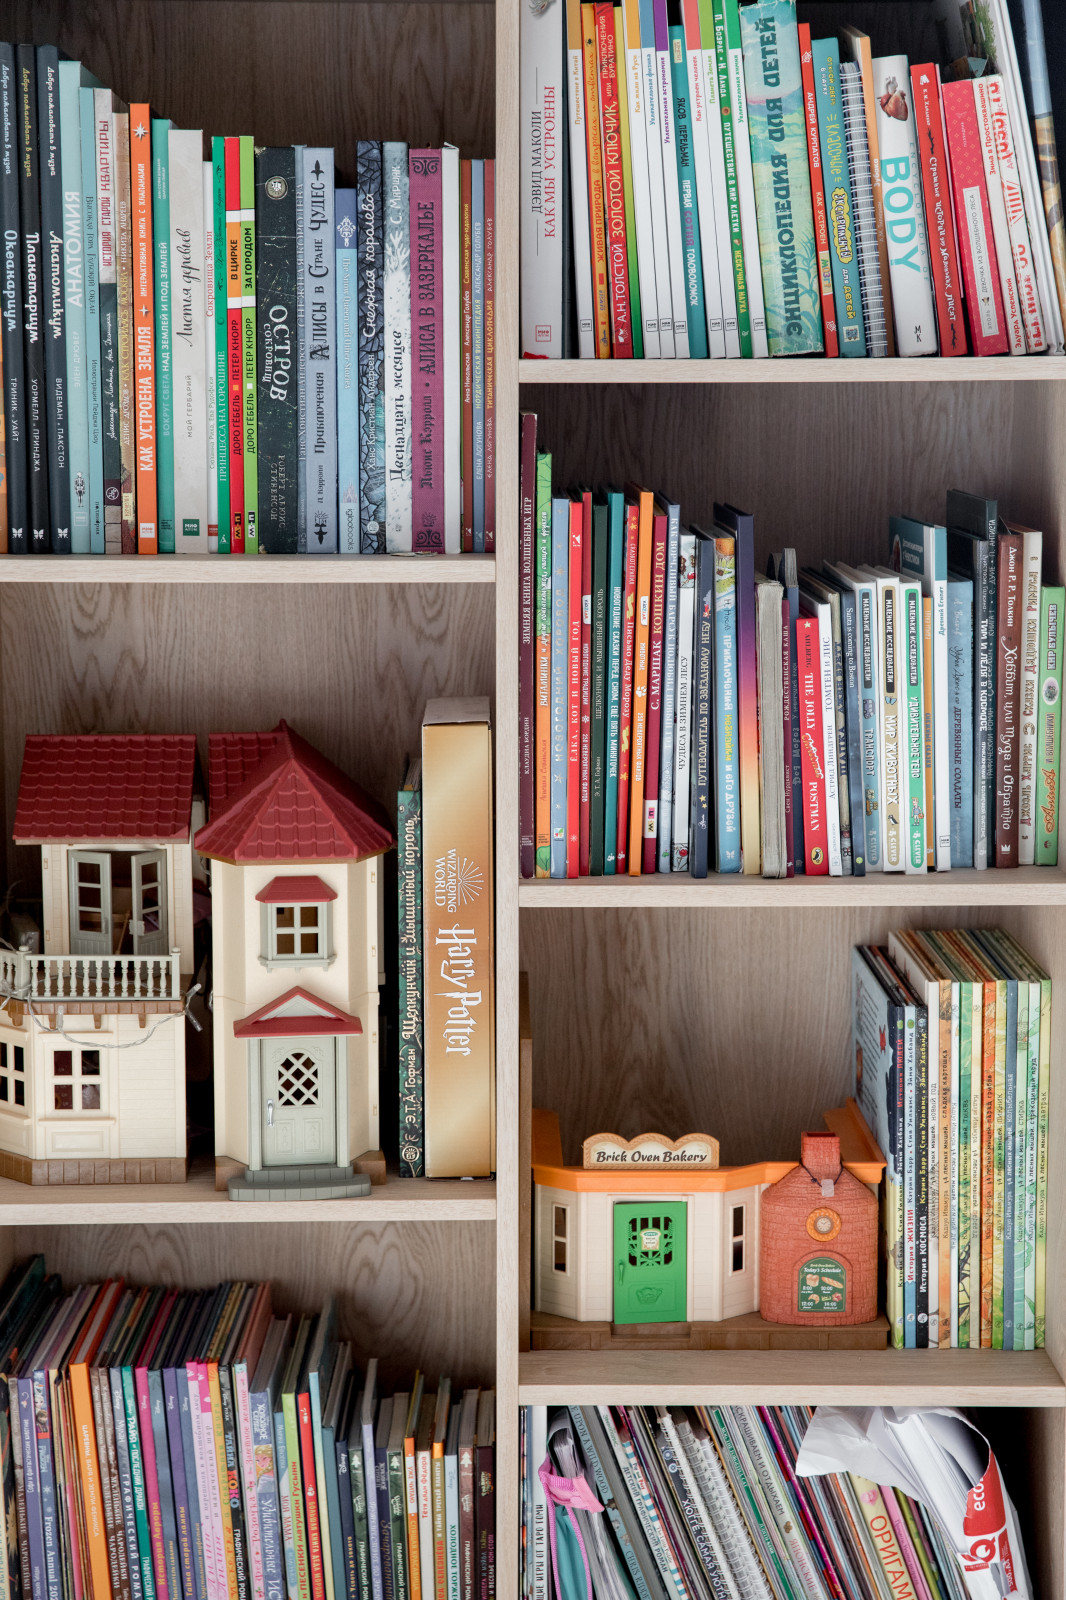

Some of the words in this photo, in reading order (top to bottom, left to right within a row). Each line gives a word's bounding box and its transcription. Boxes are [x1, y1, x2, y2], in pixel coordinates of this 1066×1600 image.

[599, 15, 609, 79] ПРИКЛЮЧЕНИЯ
[607, 34, 617, 78] БУРАТИНО
[754, 15, 783, 88] ДЕТЕЙ
[605, 82, 613, 97] ИЛИ
[676, 97, 687, 119] ЯКОВ
[807, 92, 817, 124] АНДРЕЙ
[543, 86, 556, 169] УСТРОЕНЫ
[604, 100, 621, 165] КЛЮЧИК,
[764, 96, 786, 142] ДЛЯ
[977, 83, 993, 147] Простоквашино
[98, 120, 111, 192] КВАРТИРЫ
[531, 110, 543, 167] МАКОЛИ
[678, 124, 690, 167] ПЕРЕЛЬМАН
[723, 121, 736, 177] ПУТЕШЕСТВИЕ
[809, 127, 821, 168] КУРПАТОВ
[137, 163, 146, 206] КЛАПАНАМИ
[988, 155, 1000, 176] Зима
[98, 196, 111, 226] СТАРОЙ
[531, 170, 543, 214] ДЭВИД
[544, 177, 556, 204] МЫ
[592, 179, 604, 225] ПРИРОДА
[607, 169, 624, 238] ЗОЛОТОЙ
[682, 179, 693, 208] ПЕРВАЯ
[815, 191, 824, 206] КАК
[138, 217, 147, 238] КНИГА
[361, 193, 379, 262] королева
[390, 212, 402, 225] С.
[544, 207, 556, 238] КАК
[684, 210, 695, 246] СОТНЯ
[729, 203, 740, 233] КЛЕТКИ
[817, 209, 828, 244] УСТРОЕН
[879, 156, 921, 273] BODY
[64, 191, 83, 308] АНАТОМИЯ
[100, 231, 113, 267] ИСТОРИЯ
[175, 228, 201, 284] деревьев
[204, 231, 213, 261] Земли
[243, 227, 254, 275] ГОРОДОМ
[417, 201, 435, 301] ЗАЗЕРКАЛЬЕ
[595, 226, 606, 263] ЖИВАЯ
[769, 153, 804, 337] ЭНЦИКЛОПЕДИЯ
[3, 230, 19, 332] Океанариум
[24, 231, 41, 344] Планетариум
[48, 231, 64, 340] Анатомикум
[138, 242, 148, 297] ИНТЕРАКТИВНАЯ
[205, 263, 215, 317] Сокровища
[245, 275, 254, 289] ЗА
[611, 243, 625, 300] ТОЛСТОЙ
[686, 248, 699, 306] ГОЛОВОЛОМОК
[175, 287, 194, 347] Листья
[362, 268, 378, 338] Снежная
[418, 307, 435, 317] В
[1005, 277, 1018, 318] Успенский
[137, 326, 151, 371] ЗЕМЛЯ
[244, 317, 254, 349] КНОРР
[262, 323, 273, 382] СОКРОВИЩ
[268, 304, 292, 402] ОСТРОВ
[418, 322, 436, 375] АЛИСА
[1012, 319, 1023, 348] Эдуард
[216, 350, 227, 407] ГОРОШИНЕ
[245, 351, 254, 379] ПЕТЕР
[391, 330, 404, 389] месяцев
[138, 376, 153, 440] УСТРОЕНА
[184, 374, 193, 417] ГЕРБАРИЙ
[217, 408, 227, 422] НА
[245, 393, 255, 427] ГЁБЕЛЬ
[314, 372, 327, 454] Приключения
[246, 428, 256, 454] ДОРО
[389, 394, 407, 482] Двенадцать
[419, 394, 435, 446] Кэрролл
[139, 445, 153, 471] КАК
[217, 424, 228, 482] ПРИНЦЕССА
[420, 449, 433, 489] Льюис
[523, 496, 533, 515] ИГР
[523, 515, 533, 574] ВОЛШЕБНЫХ
[654, 541, 666, 571] ДОМ
[523, 575, 532, 605] КНИГА
[653, 573, 665, 634] КОШКИН
[523, 606, 532, 645] ЗИМНЯЯ
[701, 620, 710, 644] НЕБУ
[1046, 603, 1058, 649] БУЛЫЧЕВ
[650, 639, 662, 696] МАРШАК
[680, 655, 689, 680] ЛЕСУ
[698, 646, 710, 701] ЗВЁЗДНОМУ
[1046, 650, 1057, 671] КИР
[679, 682, 688, 724] ЗИМНЕМ
[803, 672, 815, 696] THE
[698, 702, 709, 715] ПО
[804, 699, 816, 731] JOLLY
[885, 715, 898, 739] МИР
[908, 696, 922, 757] УДИВИТЕЛЬНОЕ
[678, 733, 688, 770] ЧУДЕСА
[697, 717, 708, 786] ПУТЕВОДИТЕЛЬ
[864, 728, 876, 777] ТРАНСПОРТ
[911, 759, 922, 779] ТЕЛО
[885, 741, 899, 806] ЖИВОТНЫХ
[809, 781, 820, 832] POSTMAN
[403, 817, 419, 866] король
[434, 856, 446, 907] WORLD
[446, 848, 457, 913] WIZARDING
[434, 922, 478, 989] Harry
[401, 959, 421, 1040] Щелкунчик
[433, 990, 482, 1057] Potter
[404, 1048, 420, 1088] Гофман
[596, 1150, 628, 1163] Brick
[631, 1150, 660, 1163] Oven
[662, 1150, 708, 1163] Bakery
[906, 1209, 915, 1243] ЖИЗНИ
[919, 1215, 928, 1255] КОСМОСА
[907, 1246, 916, 1281] История
[919, 1258, 929, 1293] История
[290, 1461, 301, 1497] Гусыни
[150, 1502, 164, 1540] Авроры
[293, 1498, 305, 1543] матушки
[535, 1504, 544, 1524] ГОМИ
[182, 1536, 193, 1569] старой
[535, 1526, 544, 1546] ТАРО
[535, 1550, 544, 1559] ОТ
[869, 1515, 915, 1600] ОРИГАМ
[153, 1541, 167, 1587] История
[184, 1570, 195, 1597] Тайна
[296, 1544, 309, 1591] ПЕСЕНКИ
[535, 1561, 545, 1581] ИГРЫ
